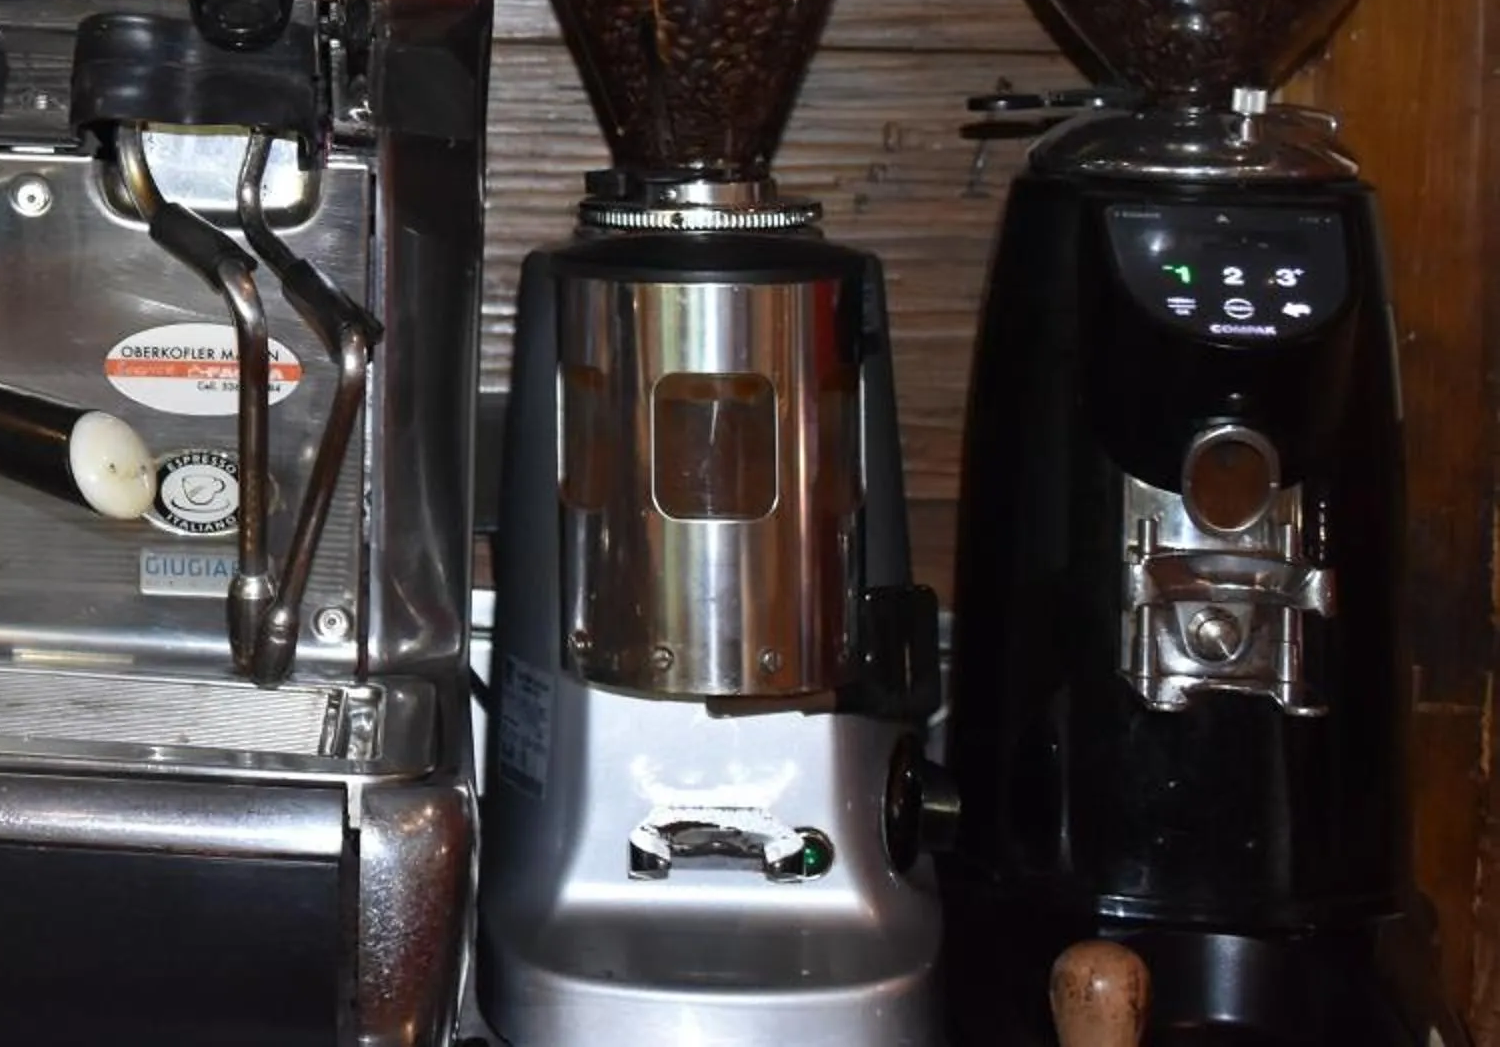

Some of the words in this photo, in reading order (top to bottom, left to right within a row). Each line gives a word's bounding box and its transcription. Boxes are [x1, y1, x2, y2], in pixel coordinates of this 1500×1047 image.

[1223, 266, 1245, 285] 2
[121, 345, 215, 361] OBERKOFLER
[167, 453, 237, 472] ESPRESSO
[167, 514, 237, 532] ITALIANO
